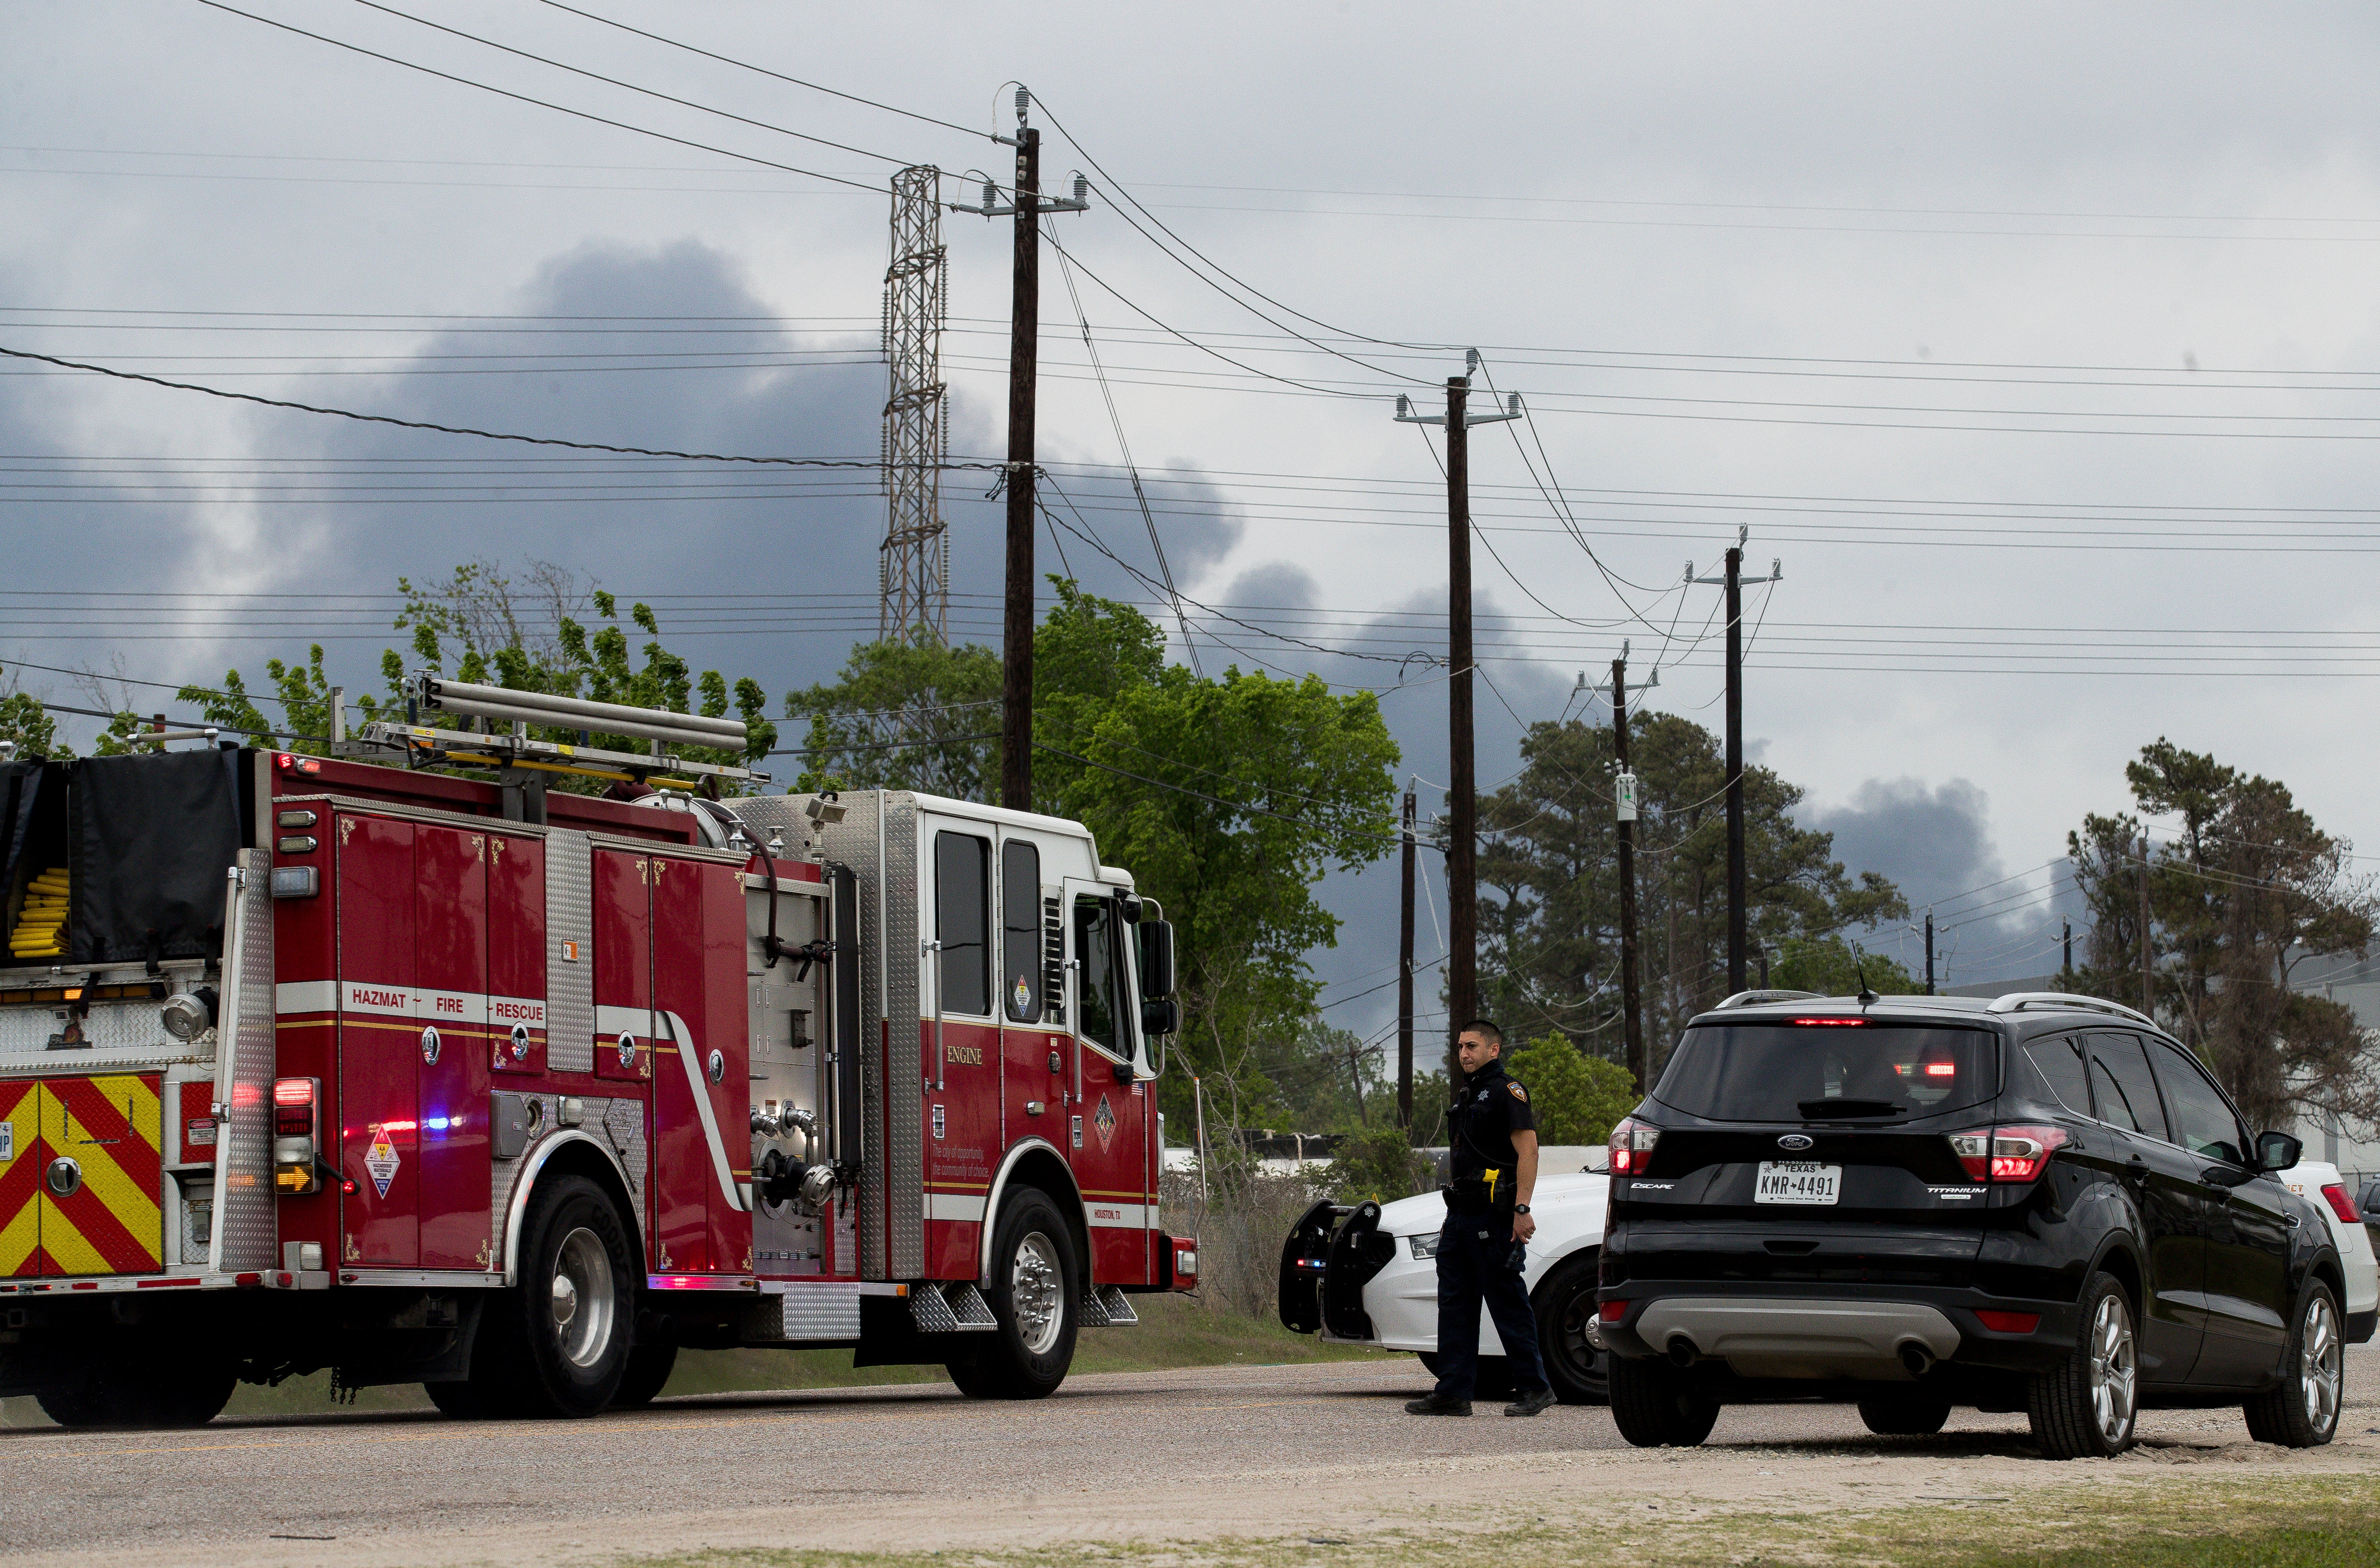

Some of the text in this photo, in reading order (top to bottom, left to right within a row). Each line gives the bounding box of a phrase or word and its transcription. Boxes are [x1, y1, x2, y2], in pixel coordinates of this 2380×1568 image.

[352, 989, 406, 1008] HAZMAT
[436, 997, 463, 1013] FIRE
[496, 1002, 543, 1021] RESCUE
[947, 1045, 982, 1065] ENGINE
[1785, 1138, 1805, 1146] Ford
[1784, 1165, 1816, 1173] TEXAS
[1760, 1175, 1833, 1196] KMR 4491
[1094, 1209, 1121, 1221] HOUSTON, TX
